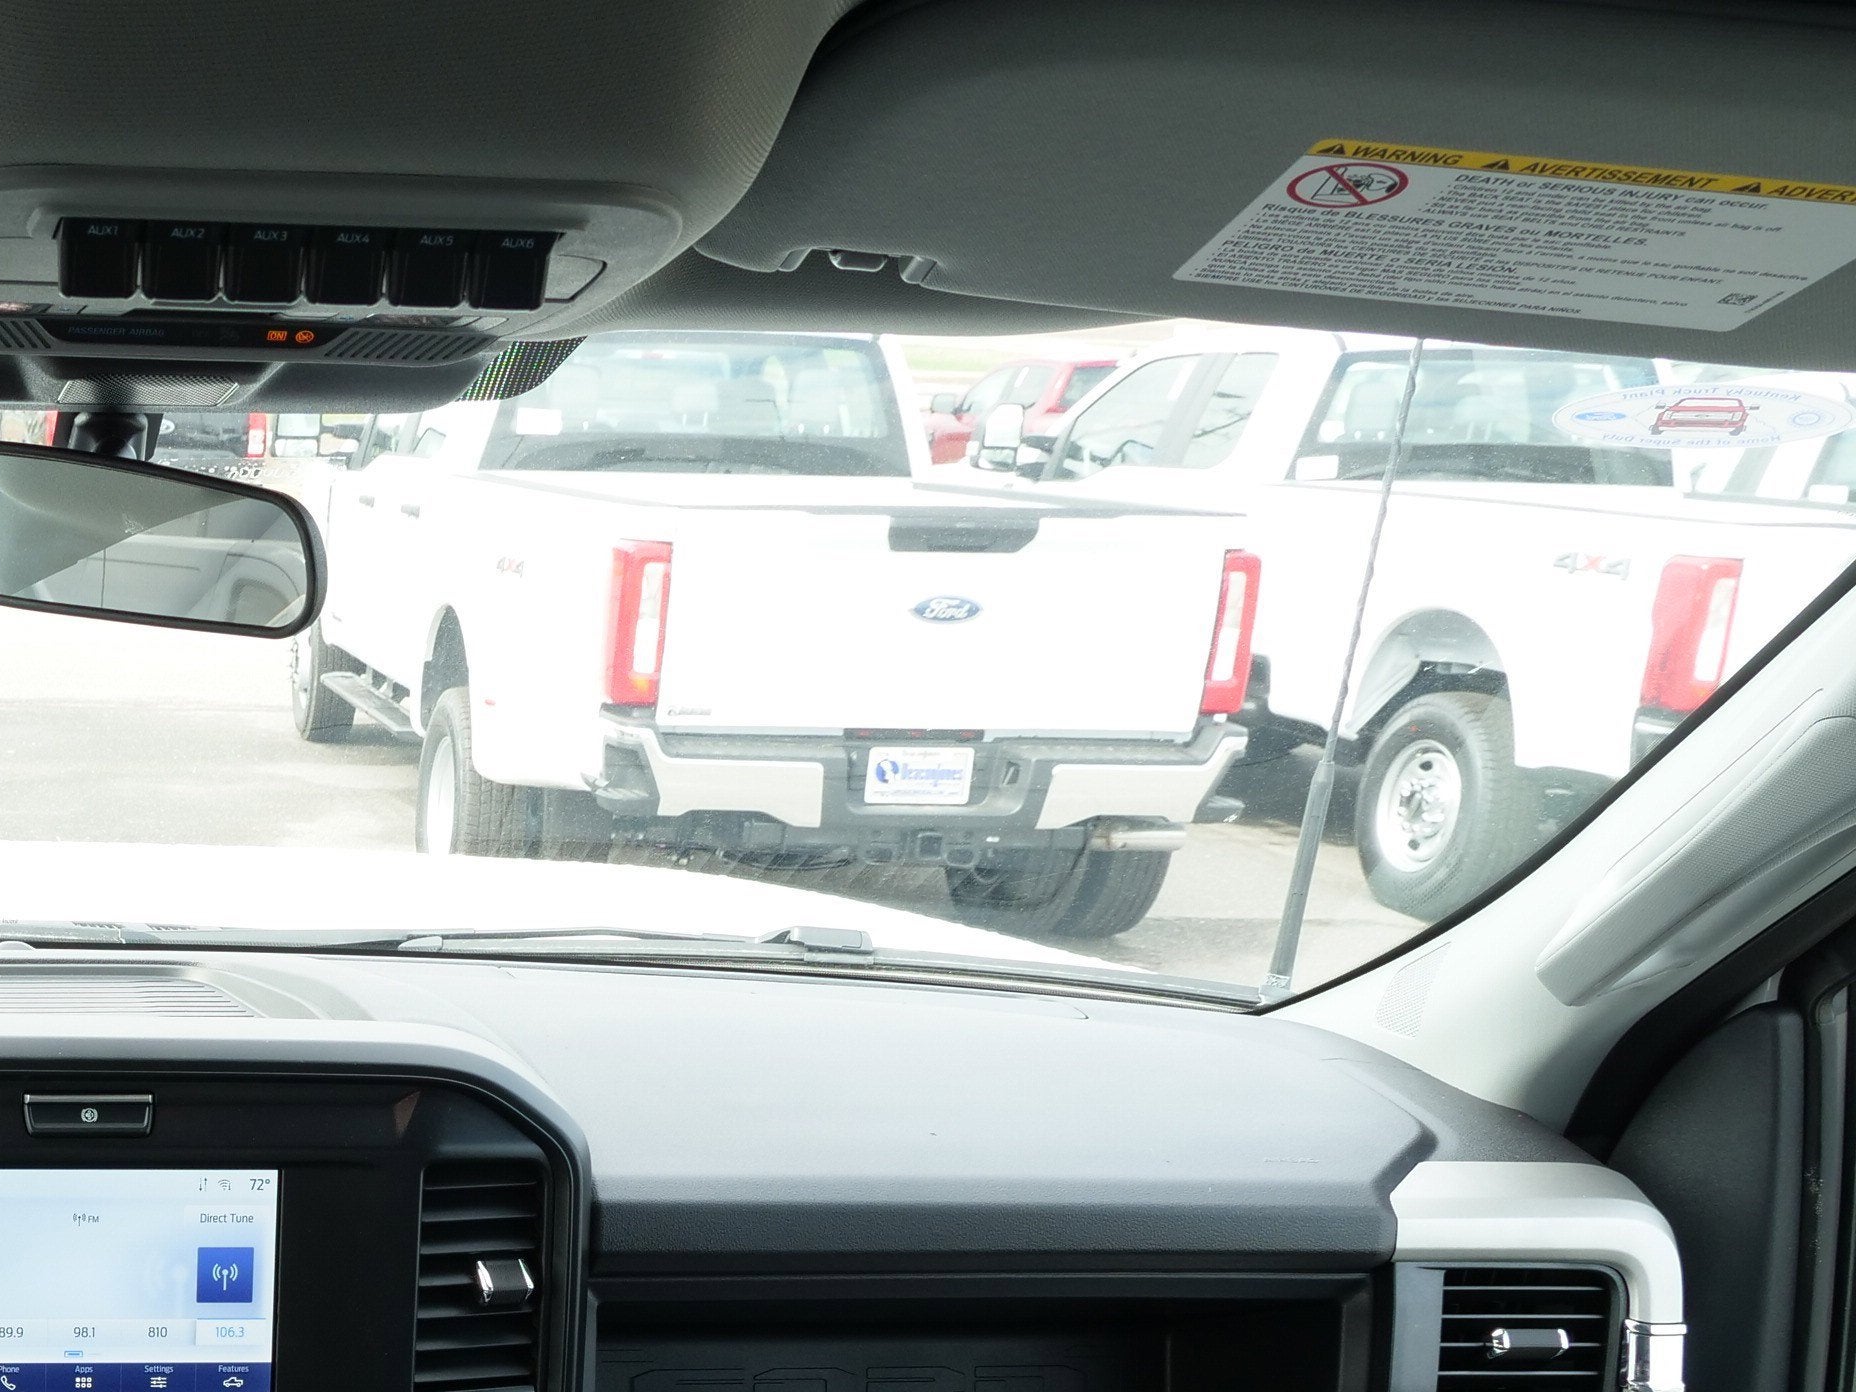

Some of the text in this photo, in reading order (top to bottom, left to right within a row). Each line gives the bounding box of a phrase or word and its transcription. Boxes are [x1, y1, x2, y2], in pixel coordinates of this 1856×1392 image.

[1351, 145, 1463, 166] WARNING
[1520, 162, 1719, 188] AVERTISSEMENT
[1454, 174, 1768, 210] DEATH or SERIOUS INJURY can occur.
[1767, 184, 1856, 202] ADVER
[68, 326, 165, 337] PASSENGER AIRBAG
[268, 331, 287, 340] ON
[249, 1177, 271, 1192] 72°
[88, 1214, 100, 1224] FM
[199, 1212, 254, 1224] Direct Tune
[73, 1326, 96, 1340] 98.1
[147, 1326, 168, 1340] 810
[214, 1326, 245, 1340] 106.3
[74, 1364, 94, 1376] Apps
[144, 1364, 174, 1376] Settings
[218, 1364, 249, 1374] Features
